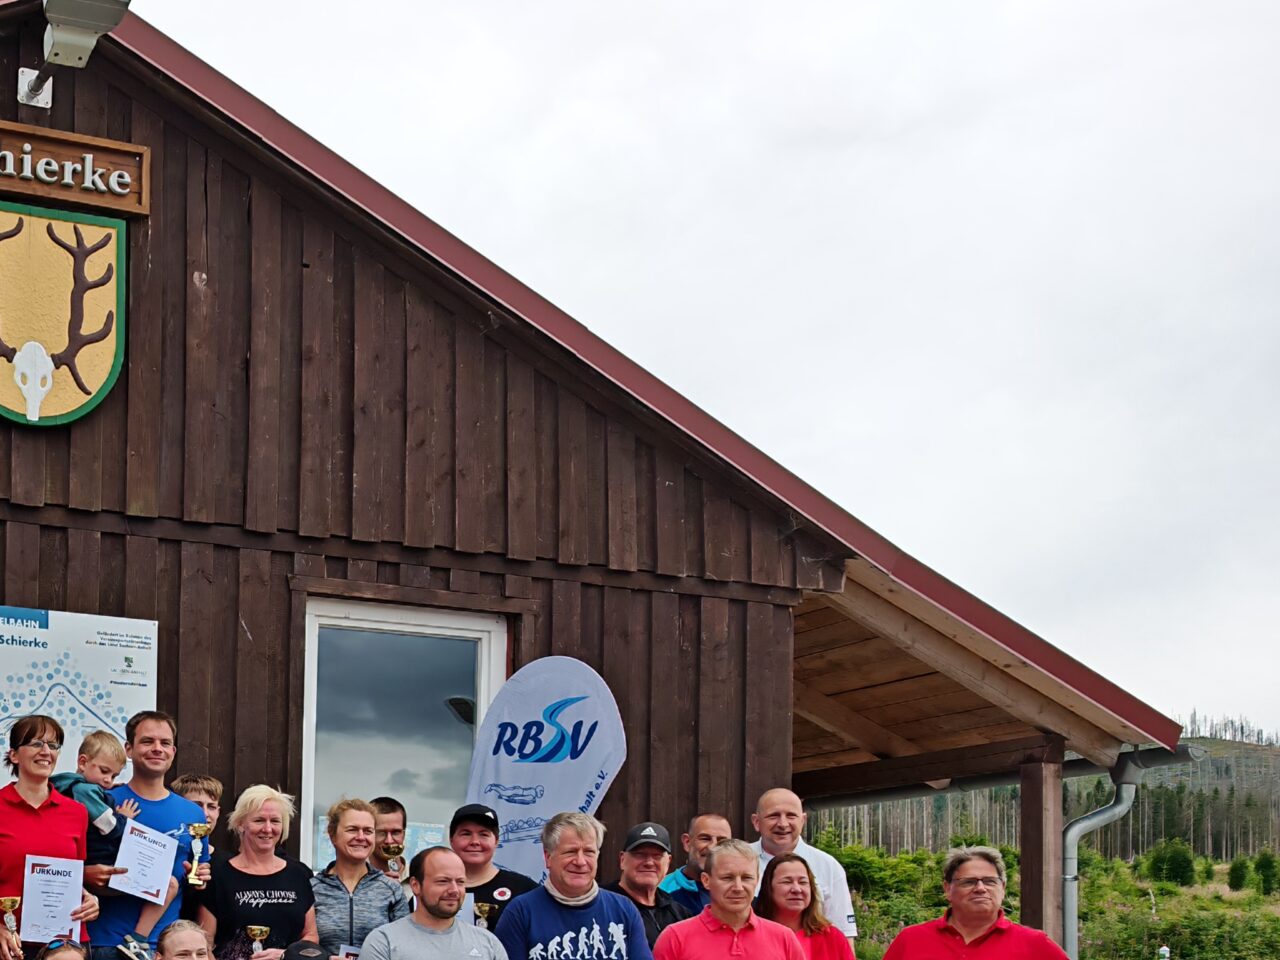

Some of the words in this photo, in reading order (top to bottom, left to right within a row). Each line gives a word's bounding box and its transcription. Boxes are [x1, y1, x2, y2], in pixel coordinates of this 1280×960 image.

[492, 696, 599, 764] RBSV
[133, 831, 168, 850] URKUNDE
[35, 868, 73, 878] URKUNDE
[235, 889, 266, 900] ALWAYS
[266, 889, 297, 899] CHOOSE
[239, 894, 295, 908] Happiness
